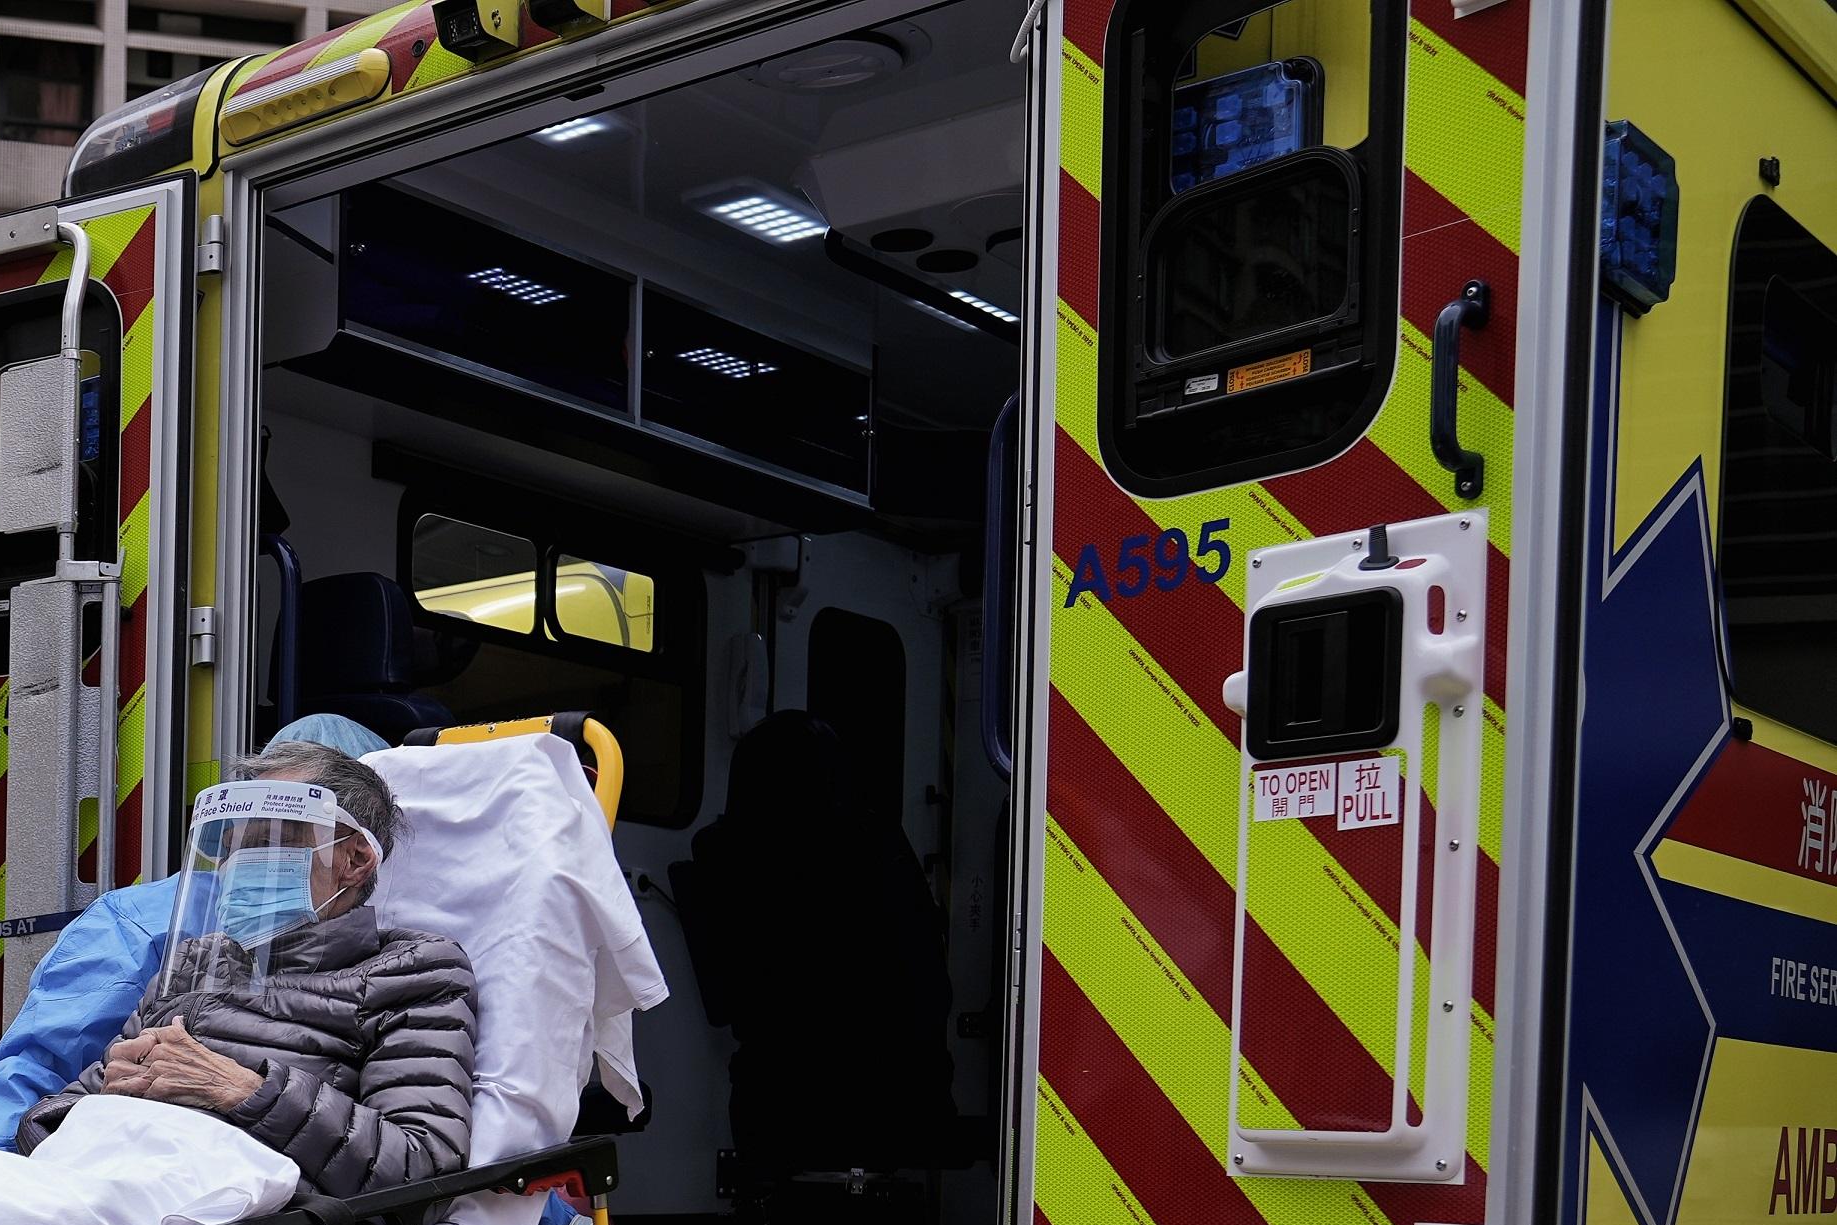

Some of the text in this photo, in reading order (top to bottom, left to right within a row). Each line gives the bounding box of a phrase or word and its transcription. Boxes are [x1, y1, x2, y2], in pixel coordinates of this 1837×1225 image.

[1064, 518, 1231, 609] A595
[1260, 769, 1330, 796] TO OPEN
[1355, 762, 1381, 792] 拉
[309, 788, 322, 799] CSI
[1271, 794, 1315, 818] 開門
[1342, 791, 1392, 823] PULL
[200, 807, 217, 818] Face
[220, 802, 253, 813] Shield
[17, 918, 36, 935] AT
[1771, 957, 1807, 1001] FIRE
[1769, 1126, 1837, 1215] AMB
